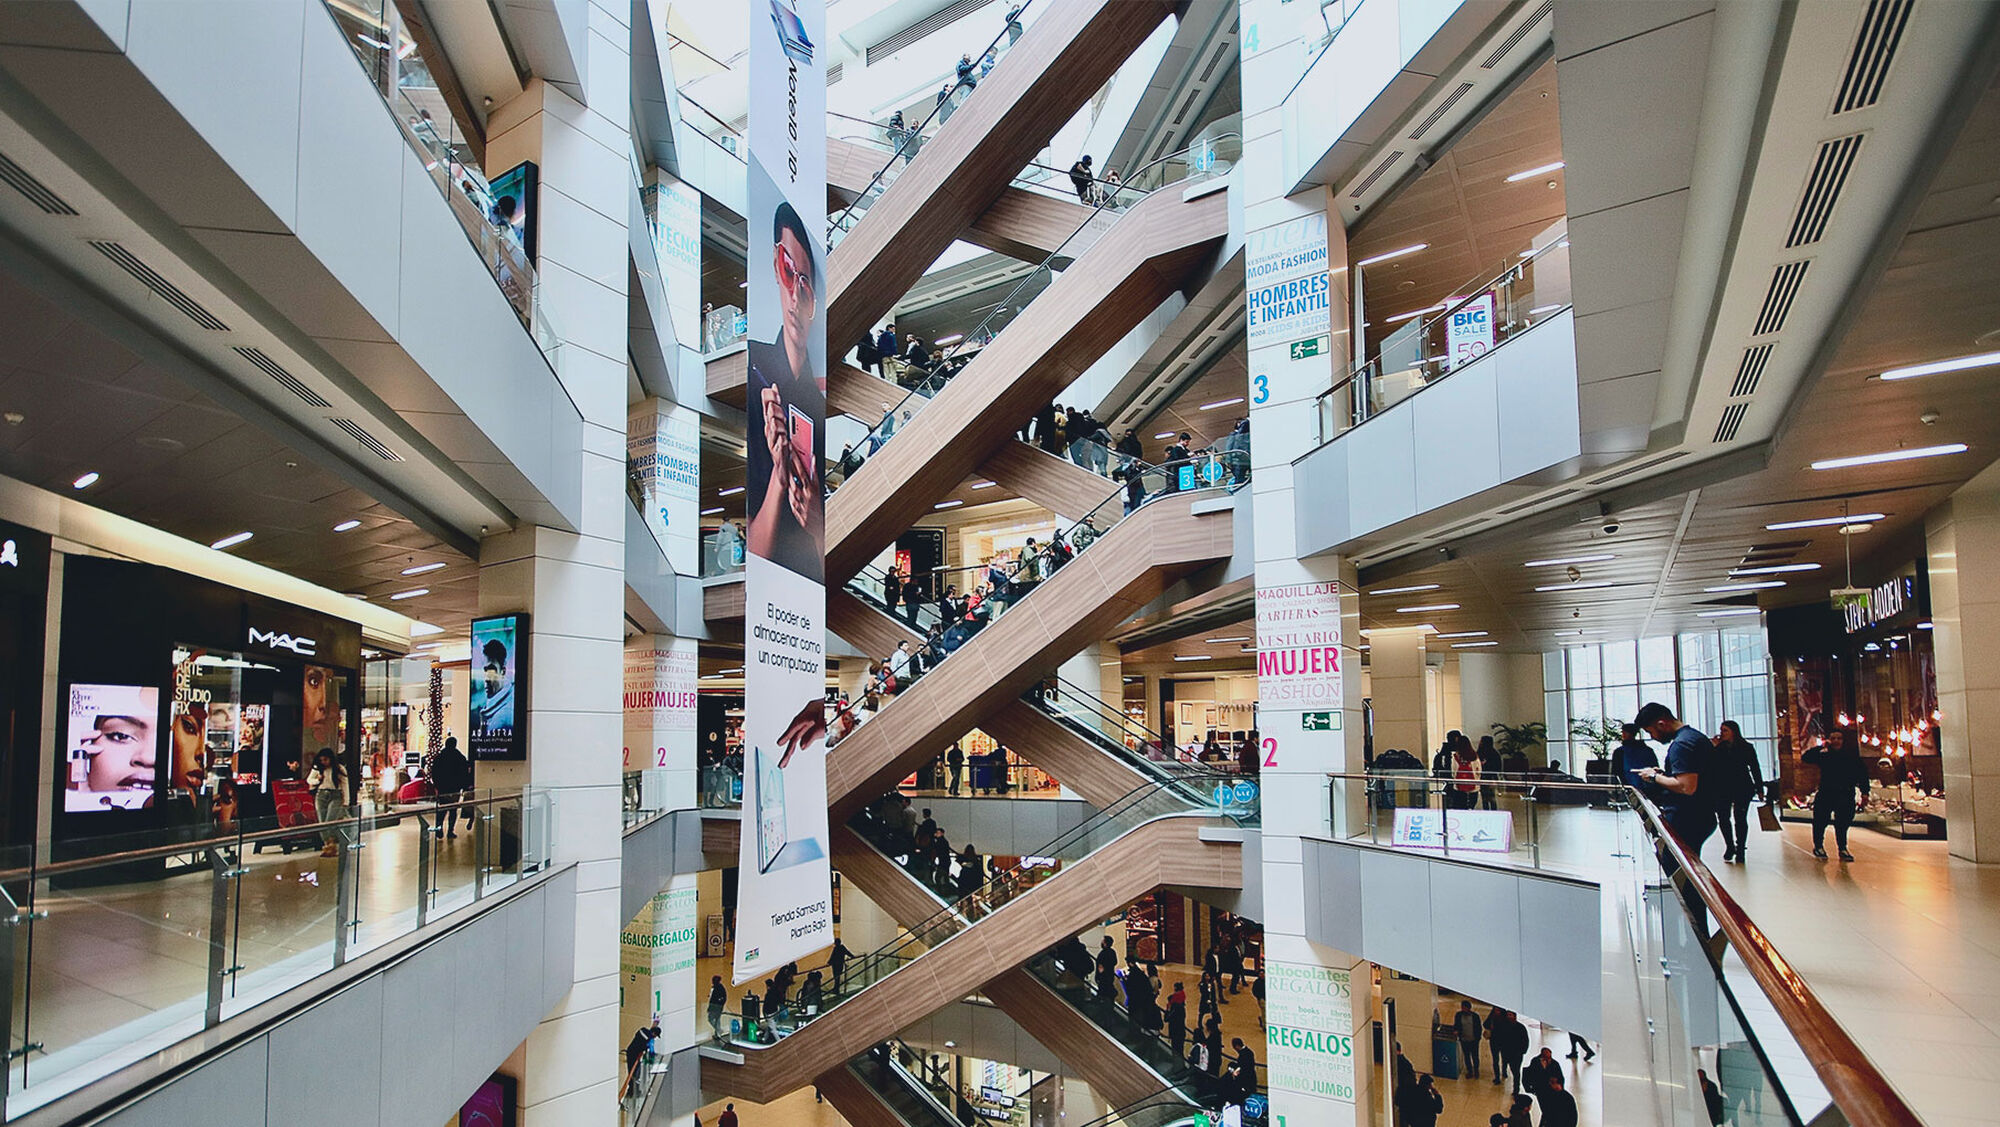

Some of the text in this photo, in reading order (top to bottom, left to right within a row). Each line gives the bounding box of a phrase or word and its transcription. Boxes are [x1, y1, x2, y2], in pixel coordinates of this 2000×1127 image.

[1244, 24, 1260, 52] 4
[659, 222, 699, 256] TECNO
[1246, 214, 1325, 255] men
[1248, 261, 1279, 279] MODA
[1281, 247, 1326, 270] FASHION
[1249, 273, 1329, 309] HOMBRES
[1250, 292, 1329, 326] E INFANTIL
[1454, 310, 1486, 326] BIG
[1454, 323, 1487, 336] SALE
[1254, 375, 1269, 404] 3
[657, 452, 699, 476] HOMBRES
[657, 466, 661, 477] E
[663, 468, 698, 488] INFANTIL
[1183, 474, 1190, 487] 3
[660, 507, 669, 526] 3
[1257, 583, 1338, 600] MAQUILLAJE
[767, 602, 811, 630] El poder de
[1257, 608, 1319, 622] CARTERAS
[753, 623, 821, 654] almacenar como
[1258, 631, 1339, 647] VESTUARIO
[654, 649, 696, 661] MAQUILLAJE
[758, 649, 819, 674] un computador
[1258, 647, 1339, 677] MUJER
[176, 661, 203, 676] ARTE
[654, 664, 688, 674] CARTERAS
[176, 673, 191, 688] DE
[654, 680, 696, 691] VESTUARIO
[175, 687, 211, 703] STUDIO
[654, 691, 696, 709] MUJER
[1260, 683, 1340, 700] FASHION
[175, 701, 190, 715] FIX
[487, 728, 512, 737] ASTRA
[623, 746, 630, 767] 2
[657, 747, 666, 767] 2
[1262, 737, 1278, 767] 2
[1409, 815, 1424, 841] BIG
[1423, 816, 1433, 841] SALE
[771, 900, 826, 927] Tienda Samsung
[652, 927, 695, 948] REGALOS
[790, 917, 826, 940] Planta Baja
[1267, 964, 1350, 983] chocolates
[1268, 977, 1351, 999] REGALOS
[655, 990, 660, 1012] 1
[1298, 1005, 1320, 1015] books
[1269, 1011, 1352, 1032] GIFTS GIFTS
[1268, 1025, 1351, 1057] REGALOS
[1270, 1072, 1309, 1090] JUMBO
[1311, 1080, 1352, 1098] JUMBO
